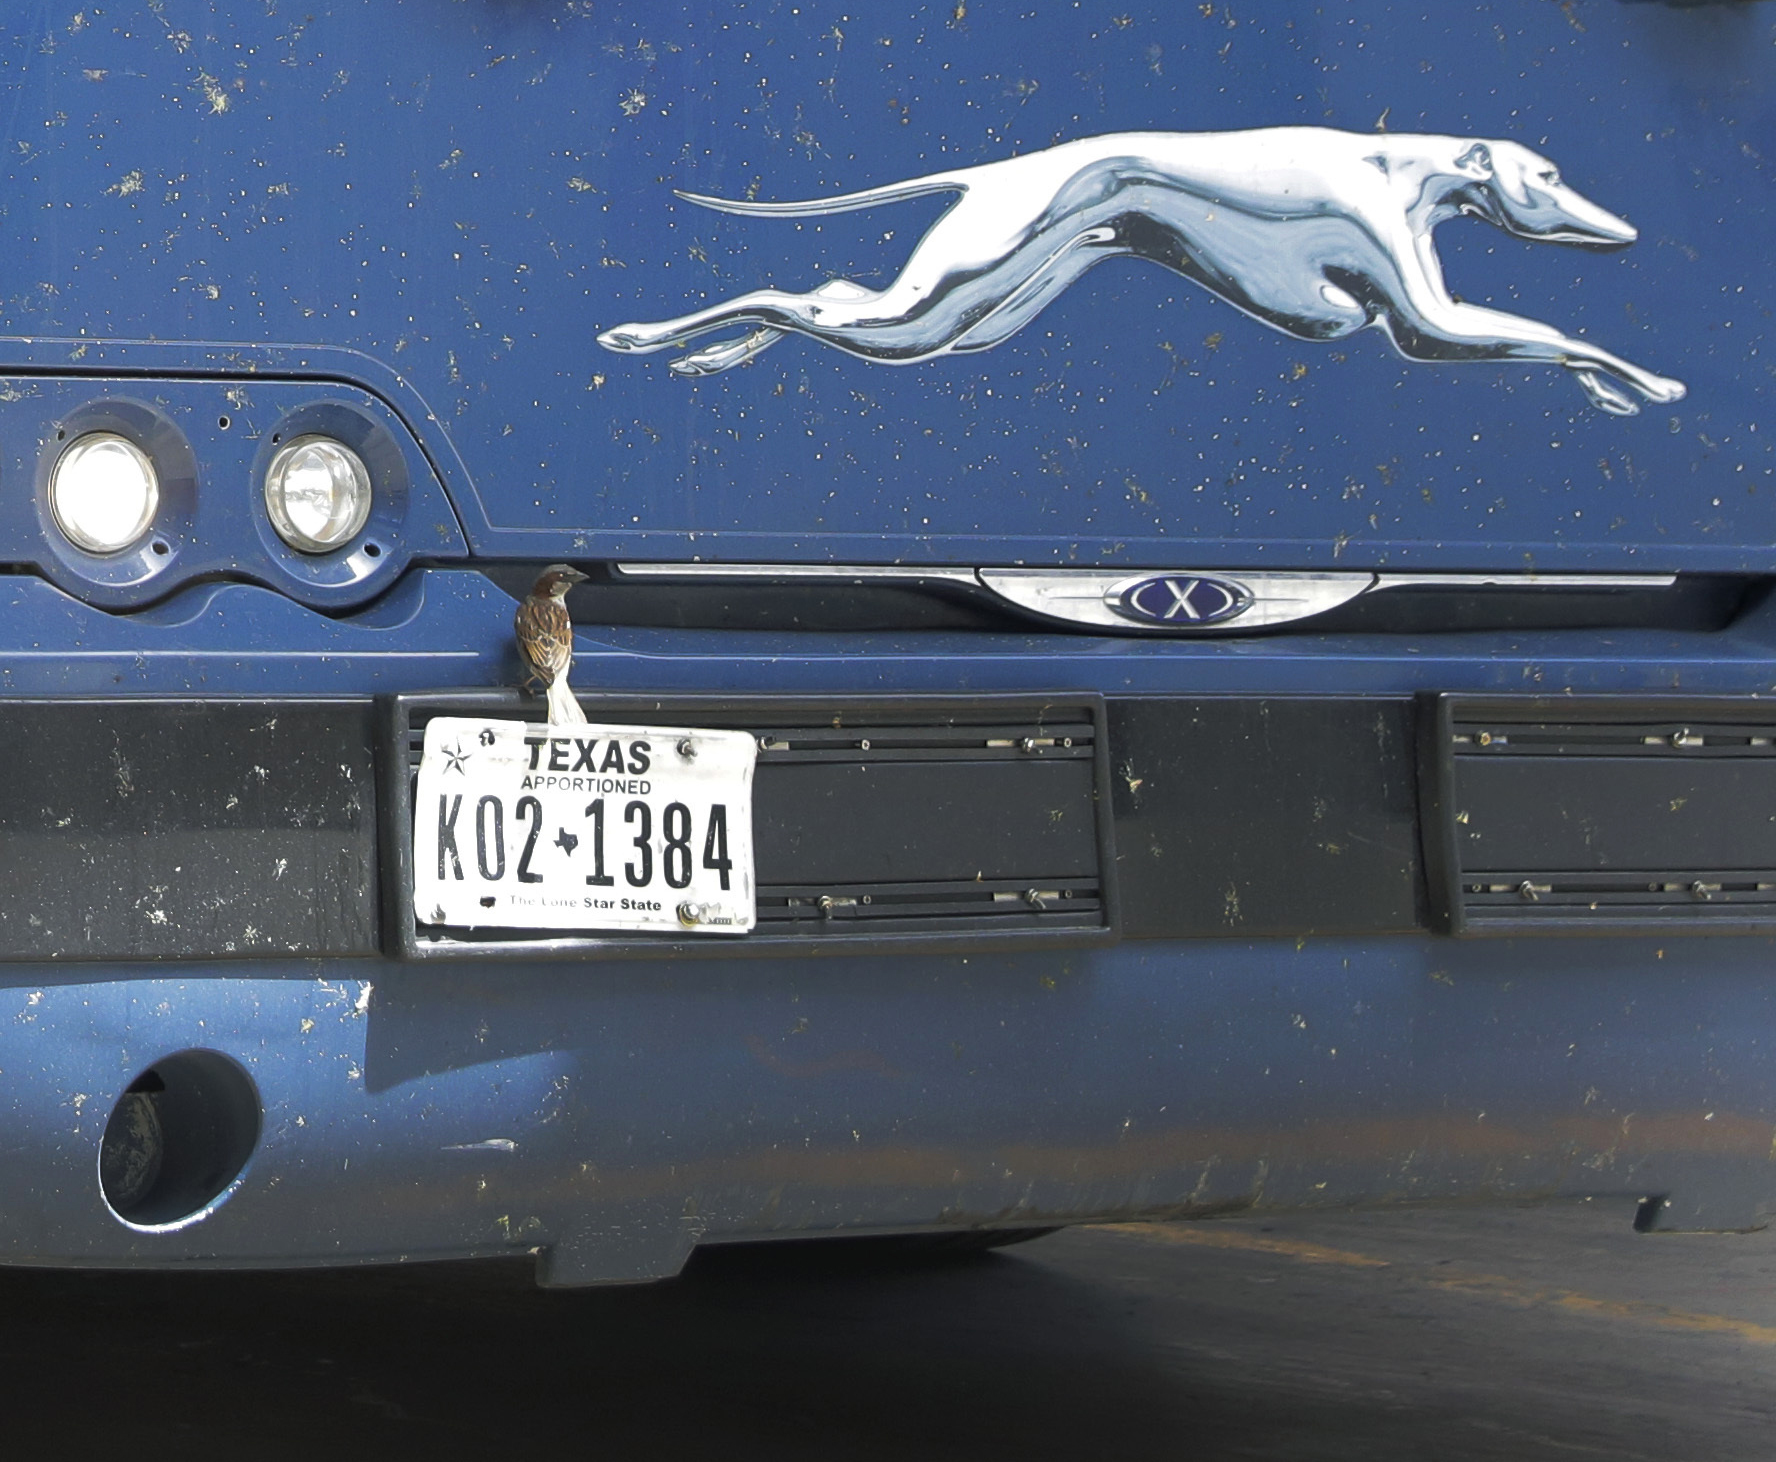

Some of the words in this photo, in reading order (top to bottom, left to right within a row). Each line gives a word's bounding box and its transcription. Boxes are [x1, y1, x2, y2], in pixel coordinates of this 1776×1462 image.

[523, 737, 653, 776] TEXAS
[520, 775, 653, 796] APPORTIONED
[583, 896, 616, 911] Star
[619, 898, 663, 912] State
